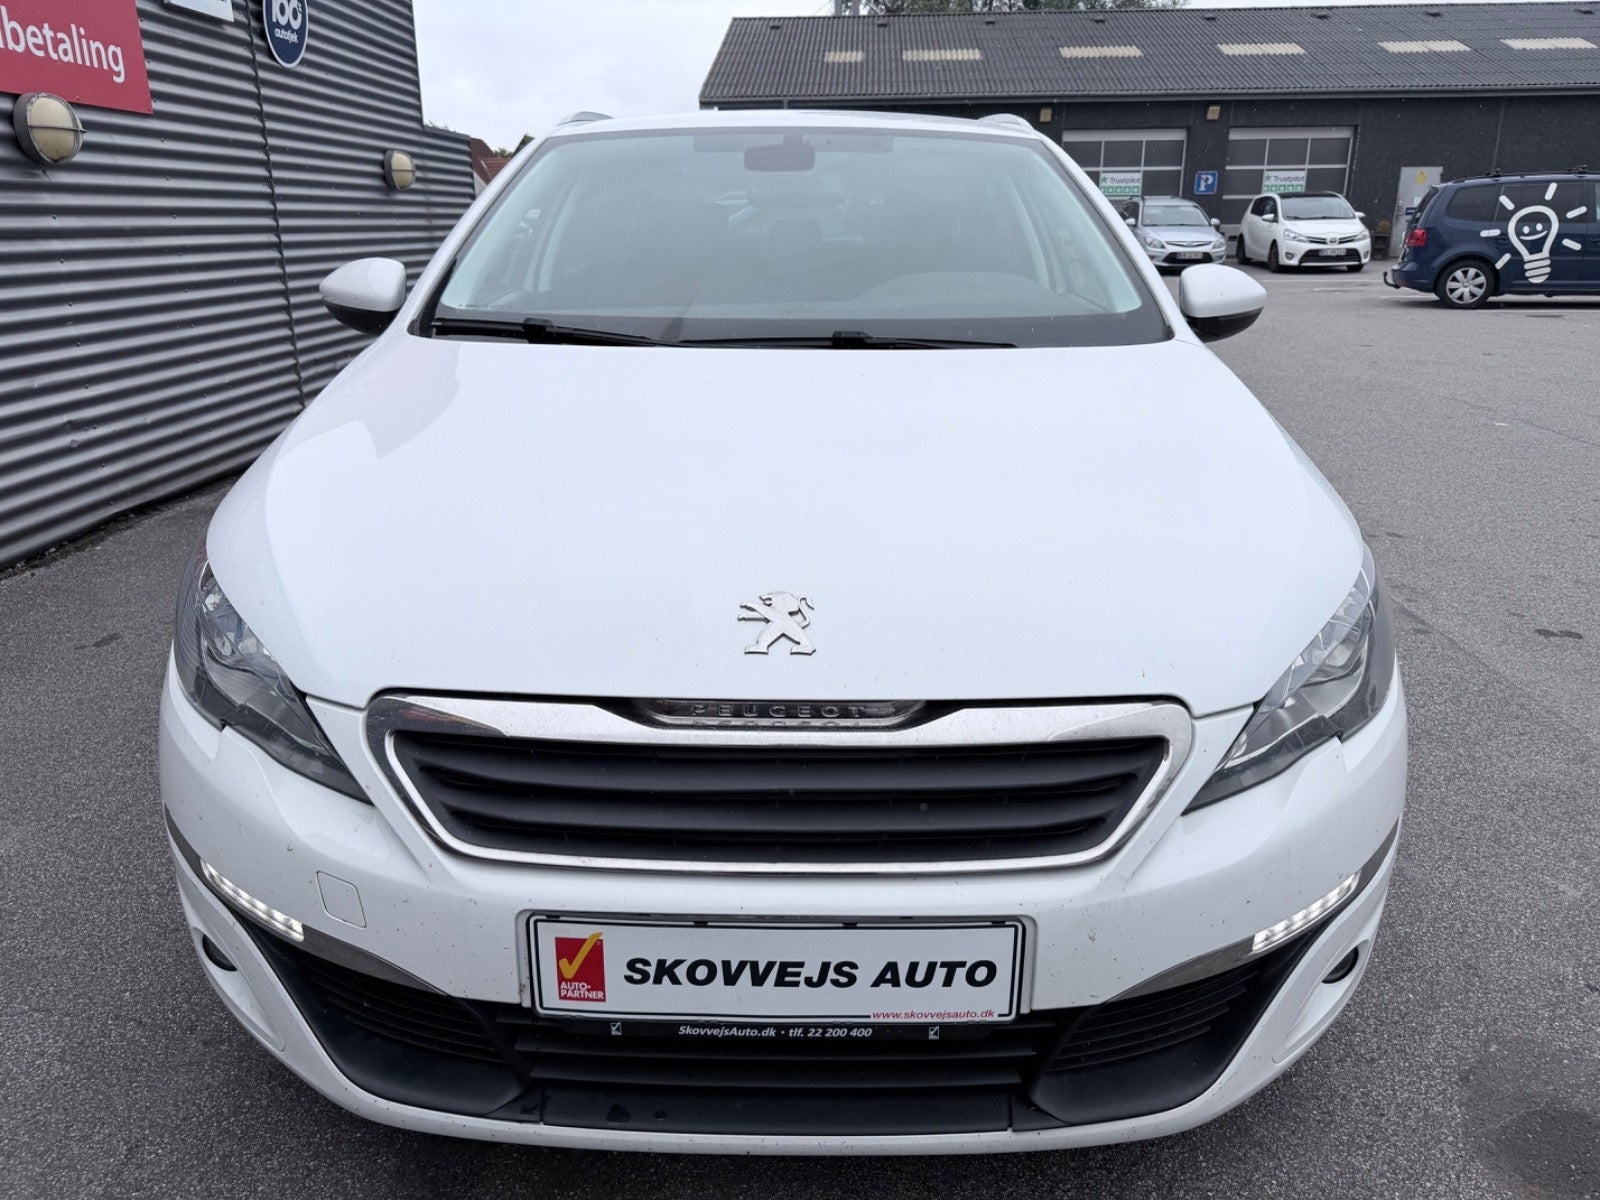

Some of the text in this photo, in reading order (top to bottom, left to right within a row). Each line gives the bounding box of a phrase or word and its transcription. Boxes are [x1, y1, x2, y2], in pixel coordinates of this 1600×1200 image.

[0, 5, 125, 83] betaling
[1110, 176, 1141, 185] Trustpilot
[1198, 174, 1214, 191] P
[1272, 175, 1305, 183] Trustpilot
[691, 704, 865, 718] PEUGEOT
[623, 957, 997, 988] SKOVVEJS AUTO
[560, 981, 592, 991] AUTO-
[560, 989, 605, 1000] PARTNER
[872, 1008, 995, 1020] www.skovvejsauto.dk
[678, 1025, 776, 1038] SkovvejsAuto.dk
[807, 1028, 822, 1038] 22
[824, 1028, 848, 1038] 200
[849, 1028, 873, 1038] 400
